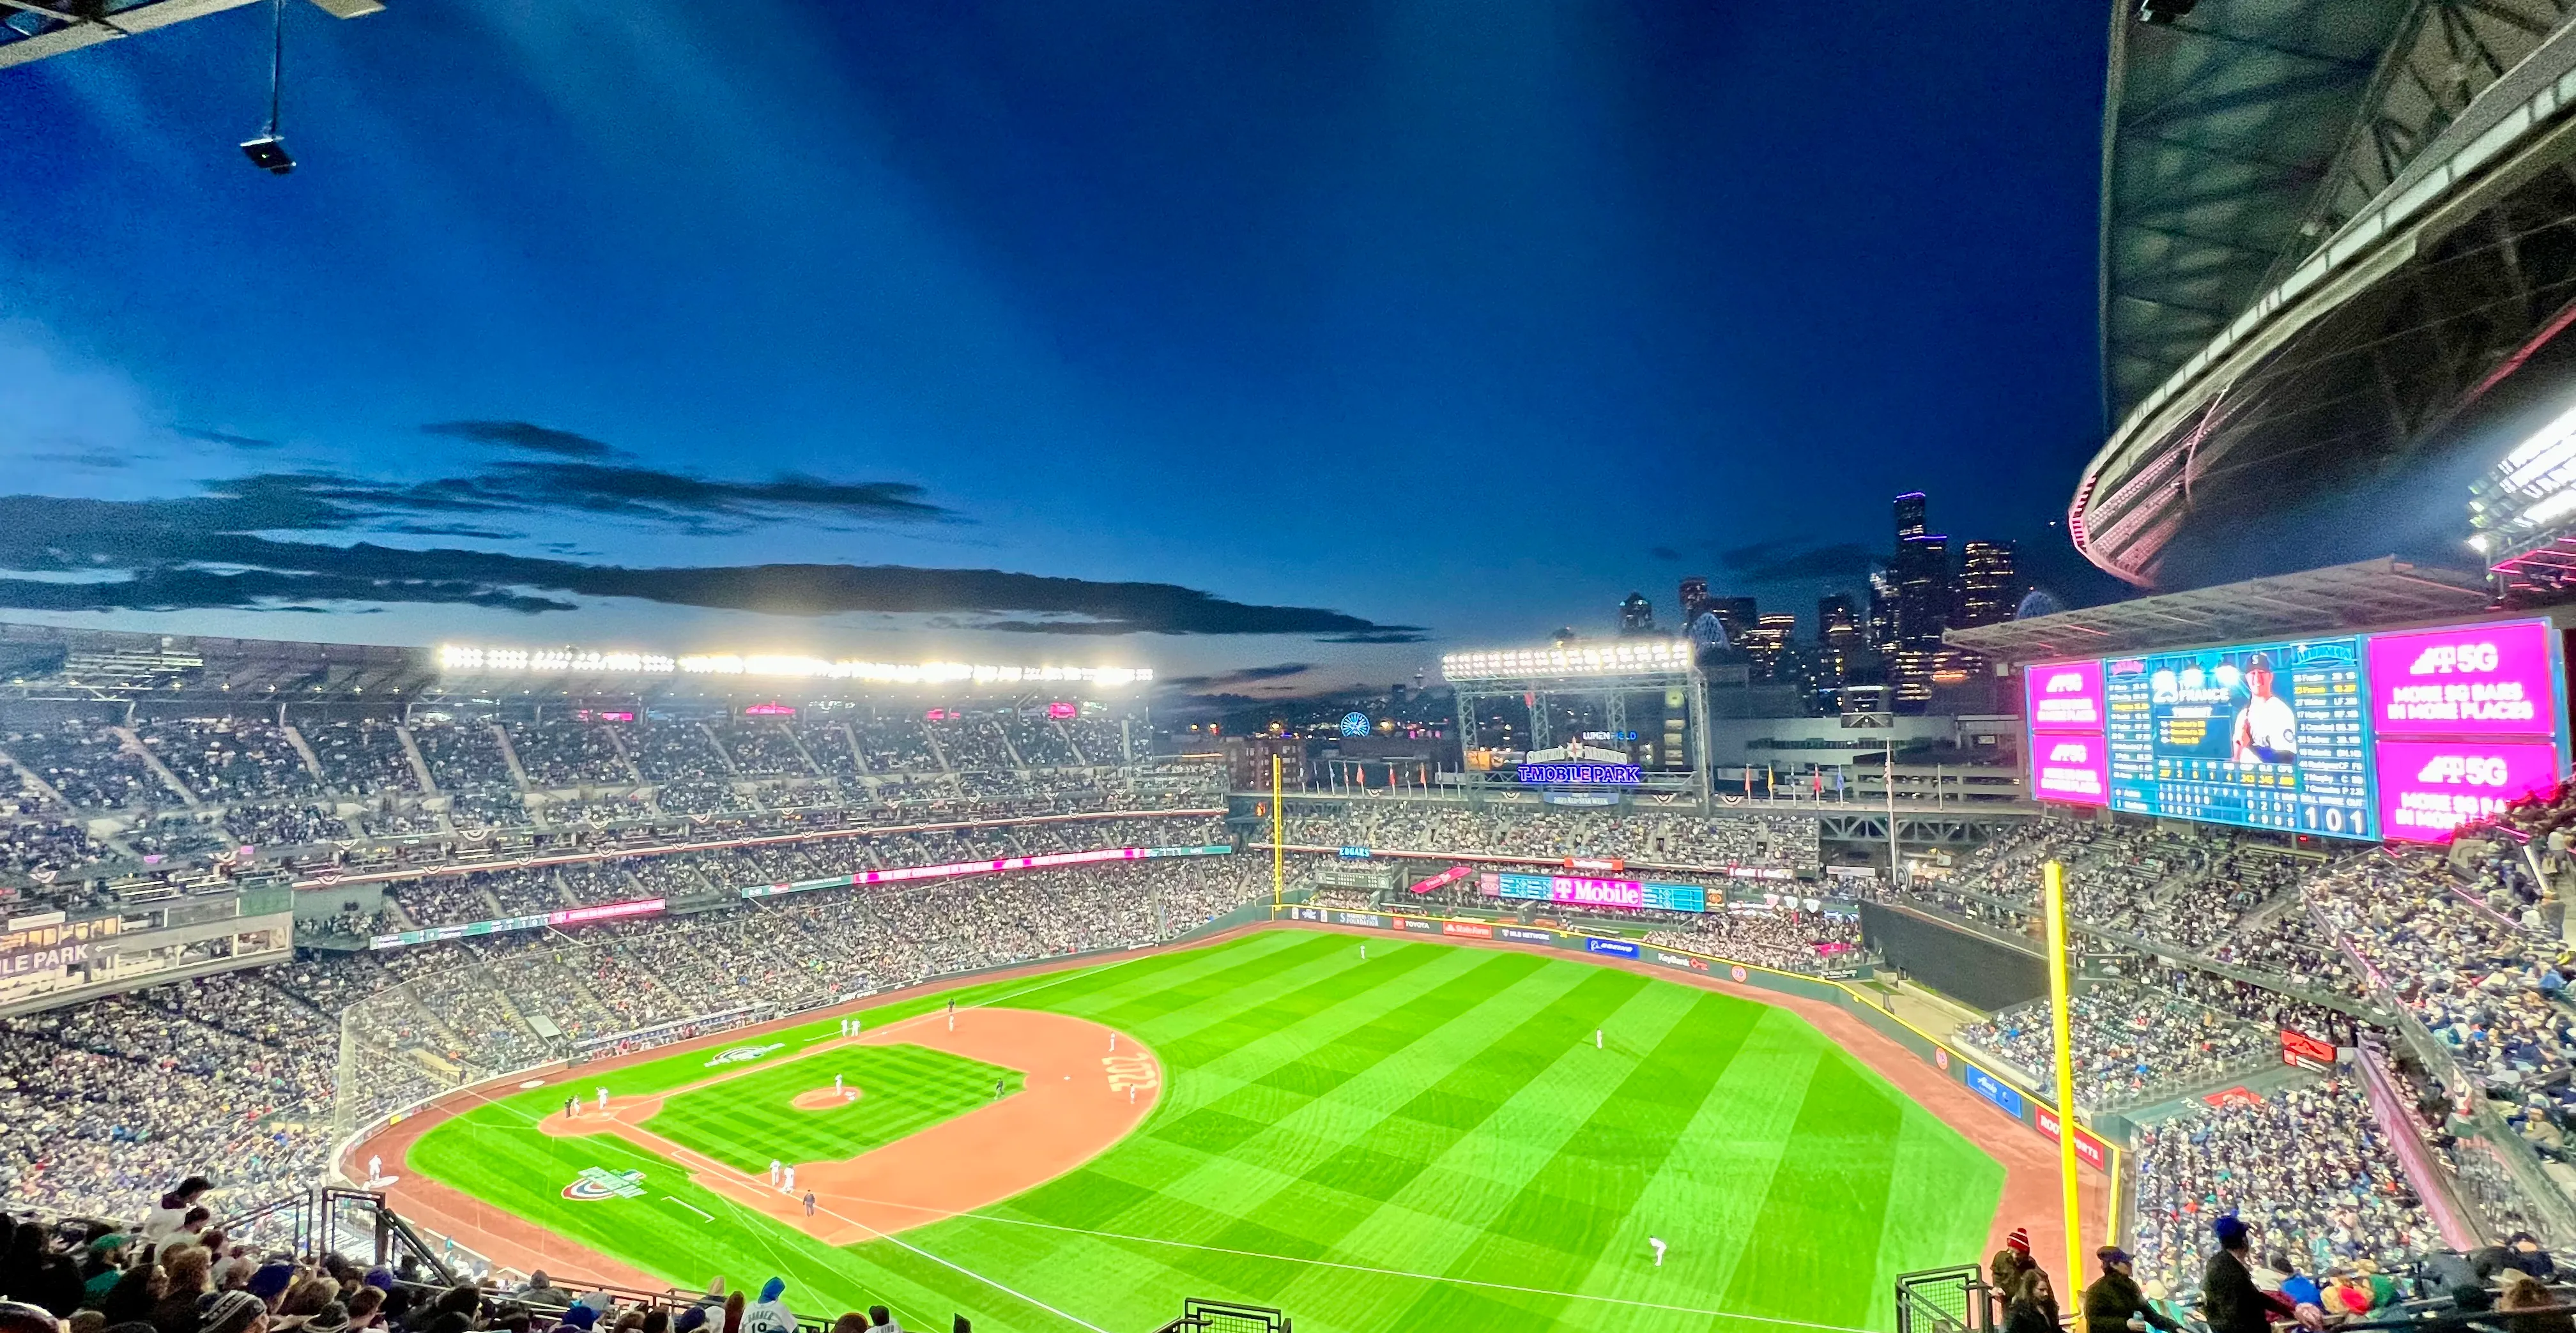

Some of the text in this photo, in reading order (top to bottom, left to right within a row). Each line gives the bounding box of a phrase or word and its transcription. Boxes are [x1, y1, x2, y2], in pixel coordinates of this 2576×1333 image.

[2457, 644, 2497, 672] 5G
[2179, 688, 2230, 702] FRANCE
[2394, 685, 2442, 702] MORE
[2471, 682, 2523, 701] BARS
[2388, 701, 2533, 720] IN MORE PLACES
[1583, 732, 1611, 740] LUMEN
[1584, 747, 1627, 763] MARINERS
[1518, 766, 1641, 783] T-MOBILE PARK
[2465, 757, 2507, 786] 5G
[2247, 800, 2253, 809] 0
[2261, 802, 2267, 810] 2
[2274, 802, 2280, 812] 0
[2287, 804, 2293, 813] 3
[2401, 792, 2450, 812] MORE
[2480, 798, 2507, 813] BA
[2159, 804, 2165, 812] 1
[2168, 805, 2174, 813] 0
[2177, 806, 2182, 814] 0
[2186, 807, 2192, 815] 2
[2196, 808, 2200, 816] 1
[2248, 814, 2254, 822] 4
[2287, 818, 2294, 826] 5
[2305, 807, 2361, 834] 1 0 1
[1574, 881, 1639, 905] Mobile
[1346, 918, 1379, 926] FOUNDATION
[1405, 920, 1430, 929] TOYOTA
[1522, 932, 1550, 941] NETWORK
[33, 943, 89, 969] PARK
[1600, 943, 1633, 952] BOEING
[1658, 952, 1690, 967] KeyBank
[1101, 1053, 1158, 1092] 2022
[2040, 1115, 2099, 1161] ROO ORTS
